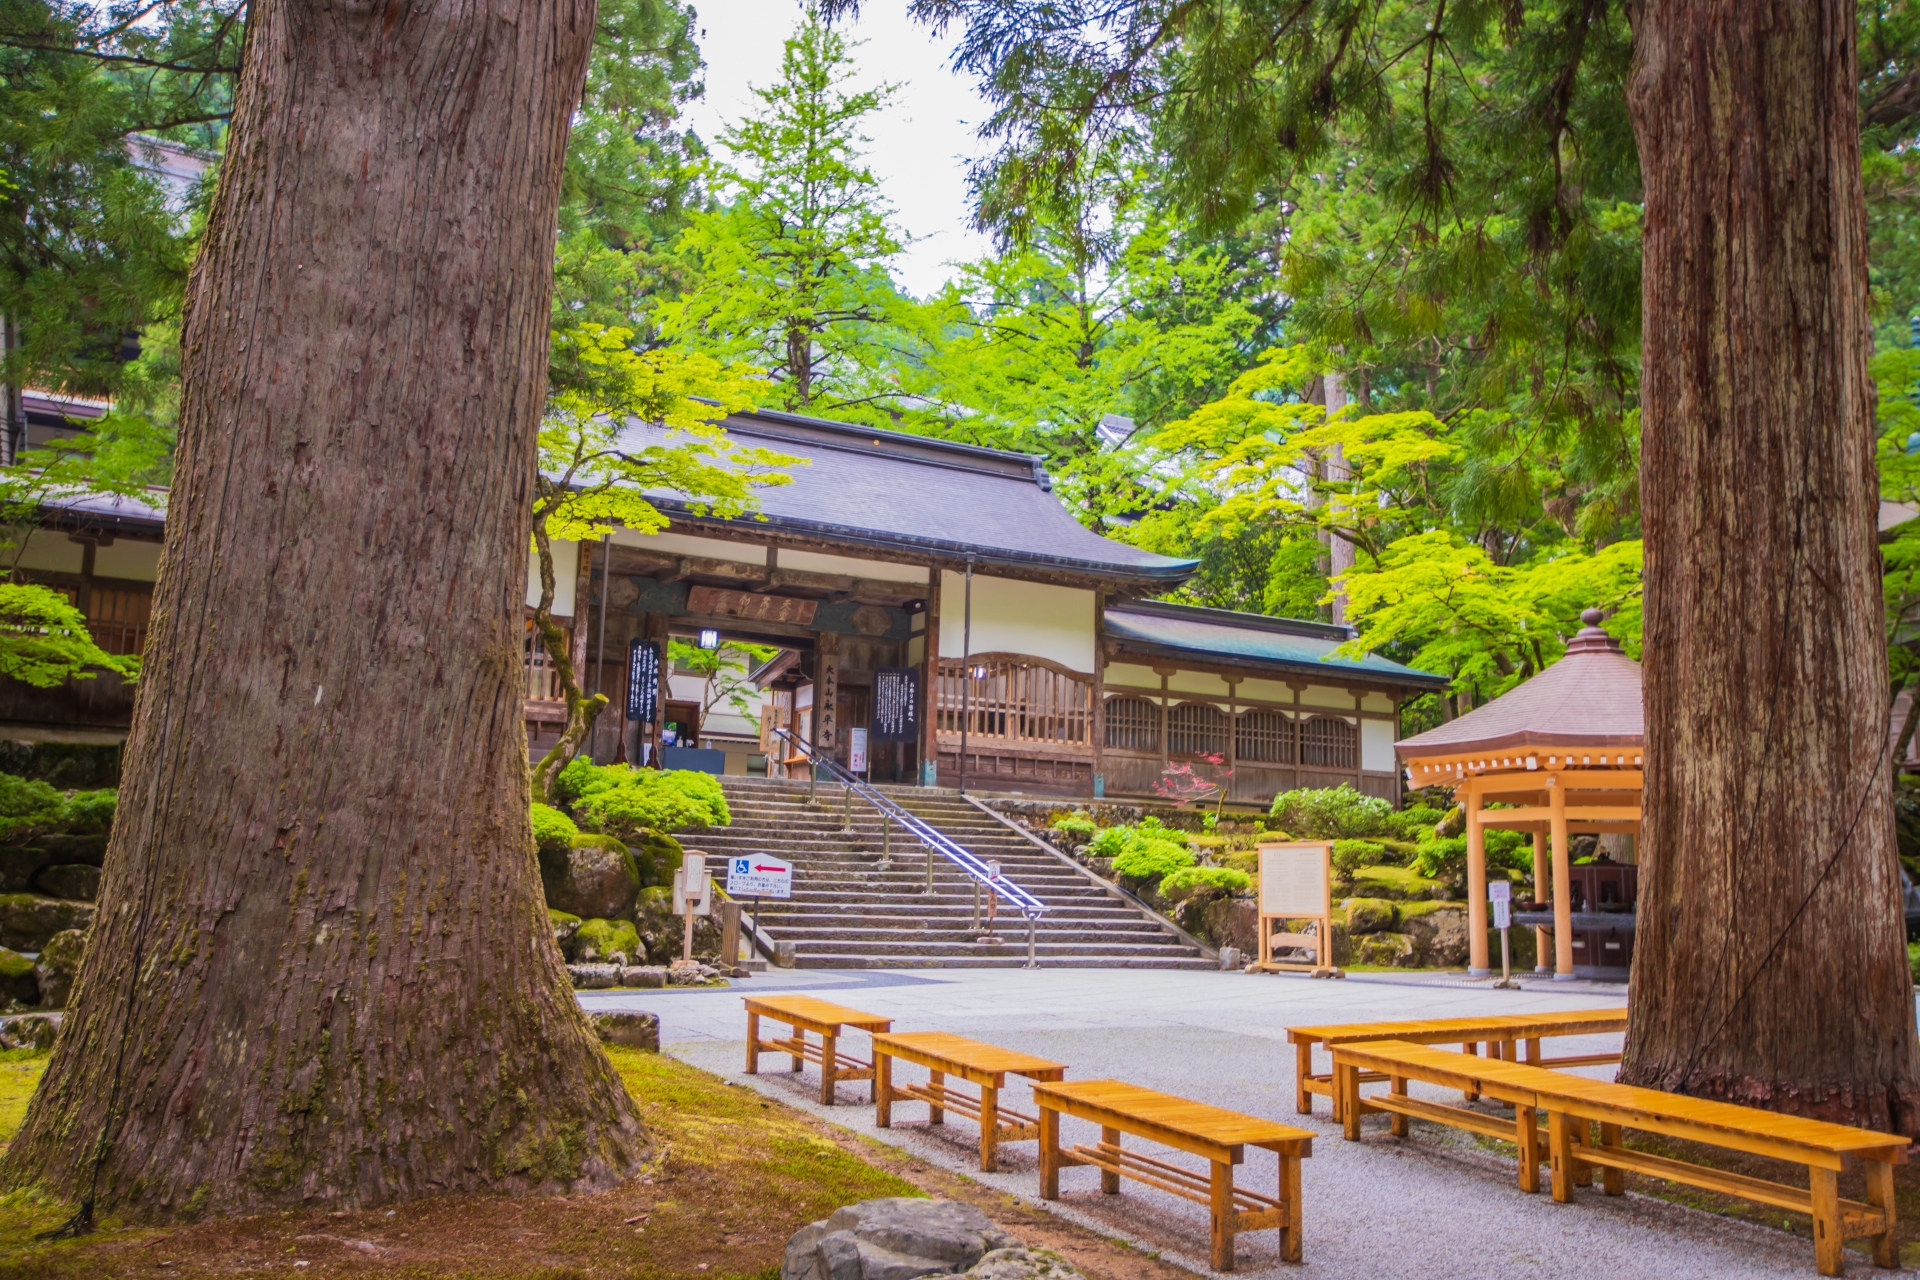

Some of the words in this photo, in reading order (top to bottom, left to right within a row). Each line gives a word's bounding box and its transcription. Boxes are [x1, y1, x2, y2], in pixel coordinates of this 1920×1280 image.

[822, 664, 834, 742] 大本山永平寺
